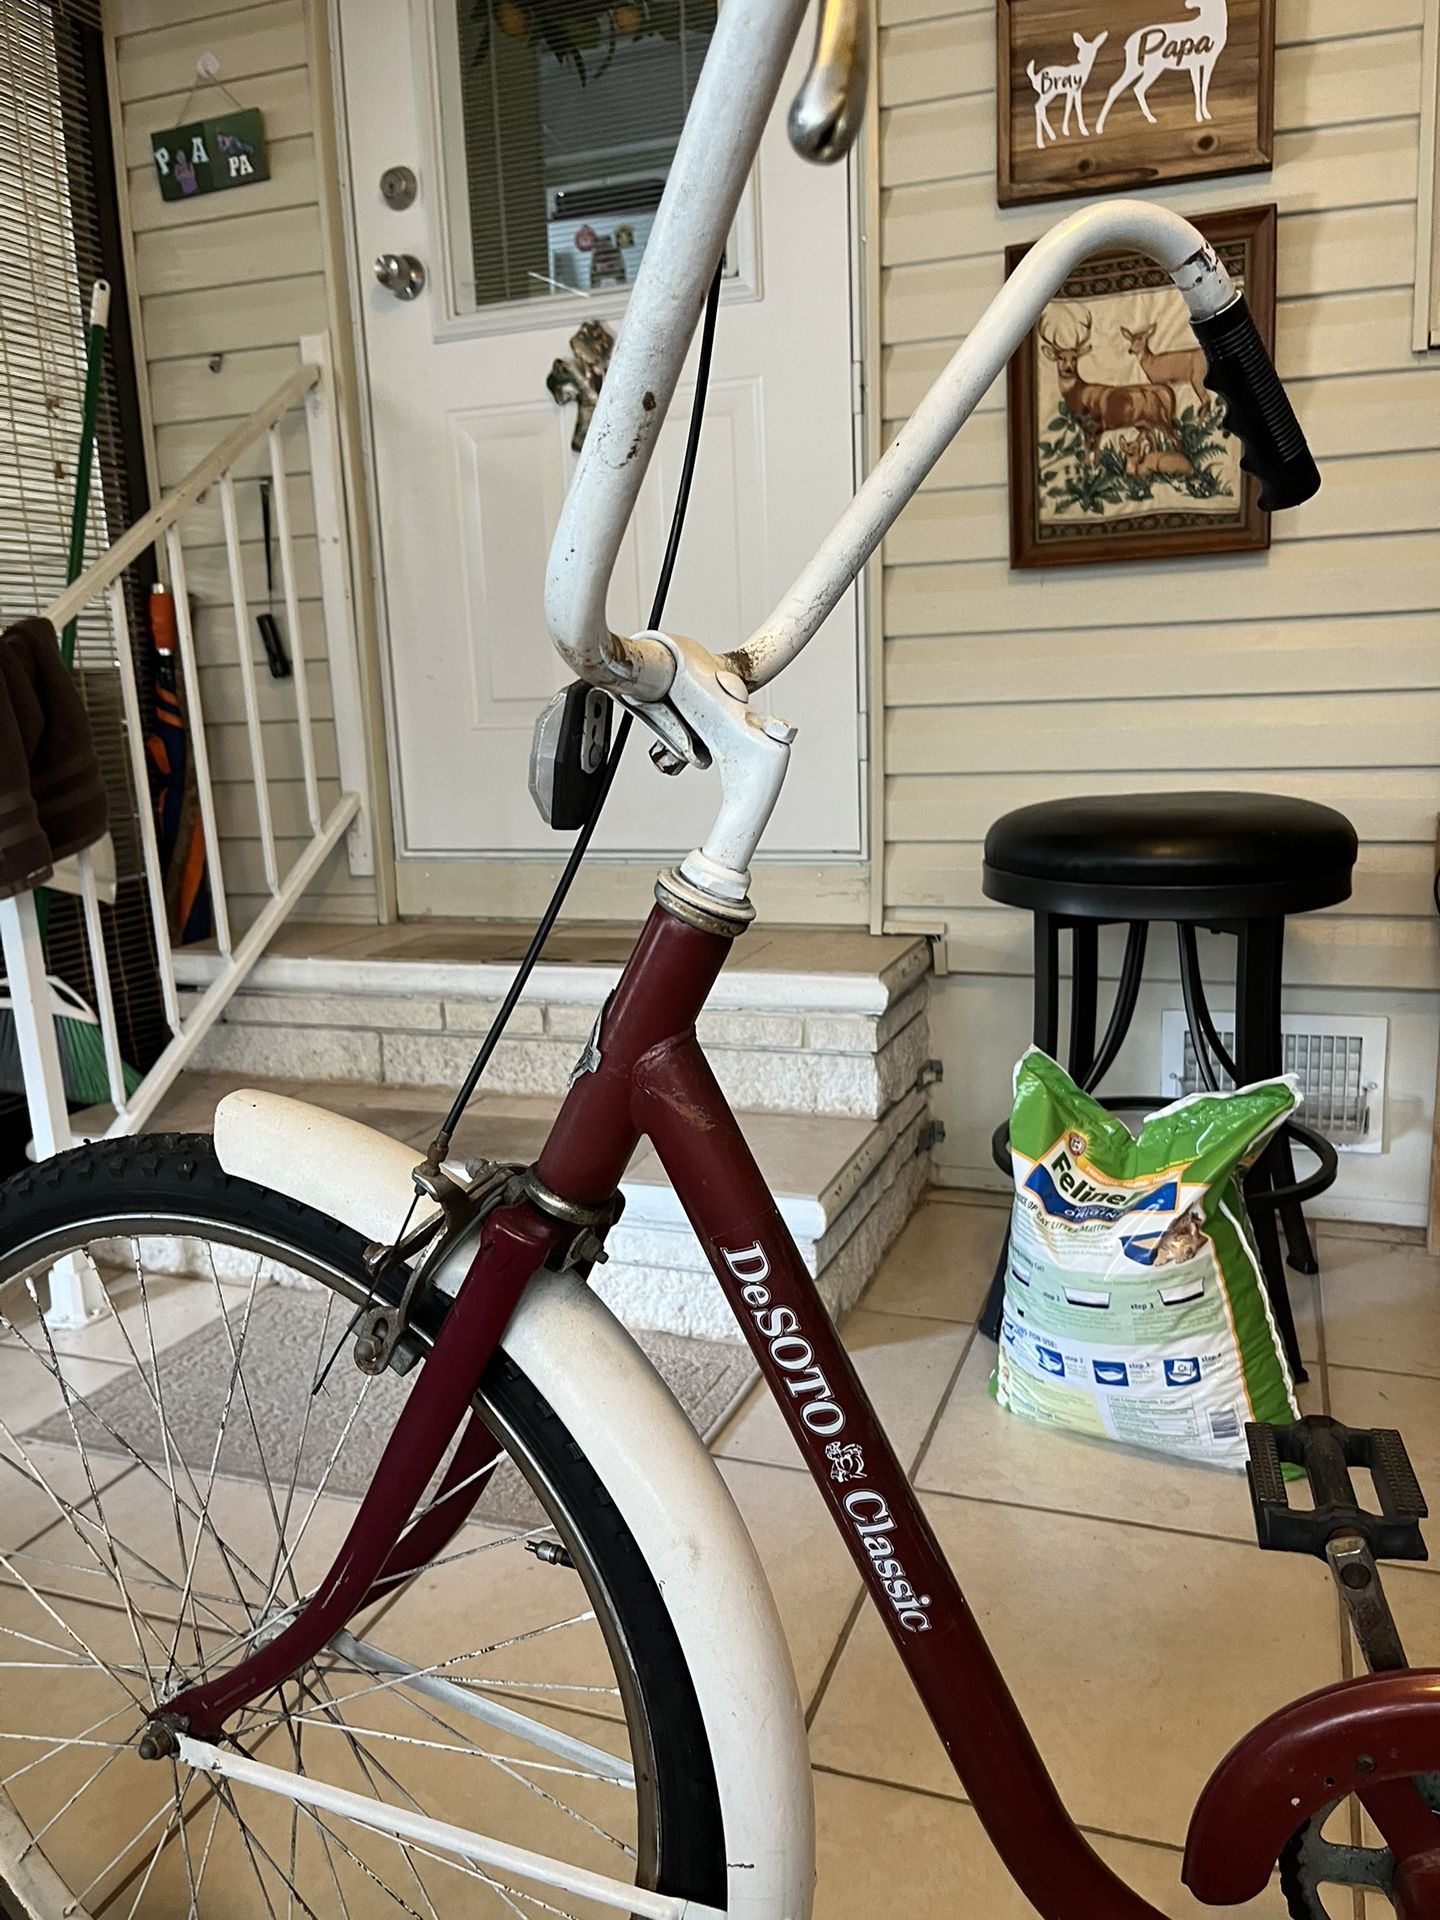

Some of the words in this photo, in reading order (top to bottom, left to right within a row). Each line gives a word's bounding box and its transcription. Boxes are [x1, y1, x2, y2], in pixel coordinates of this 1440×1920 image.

[1138, 28, 1214, 67] Papa
[1041, 71, 1082, 94] Bray
[1051, 1151, 1126, 1206] Feline
[721, 1240, 847, 1437] DeSOTO
[842, 1488, 932, 1633] Classic
